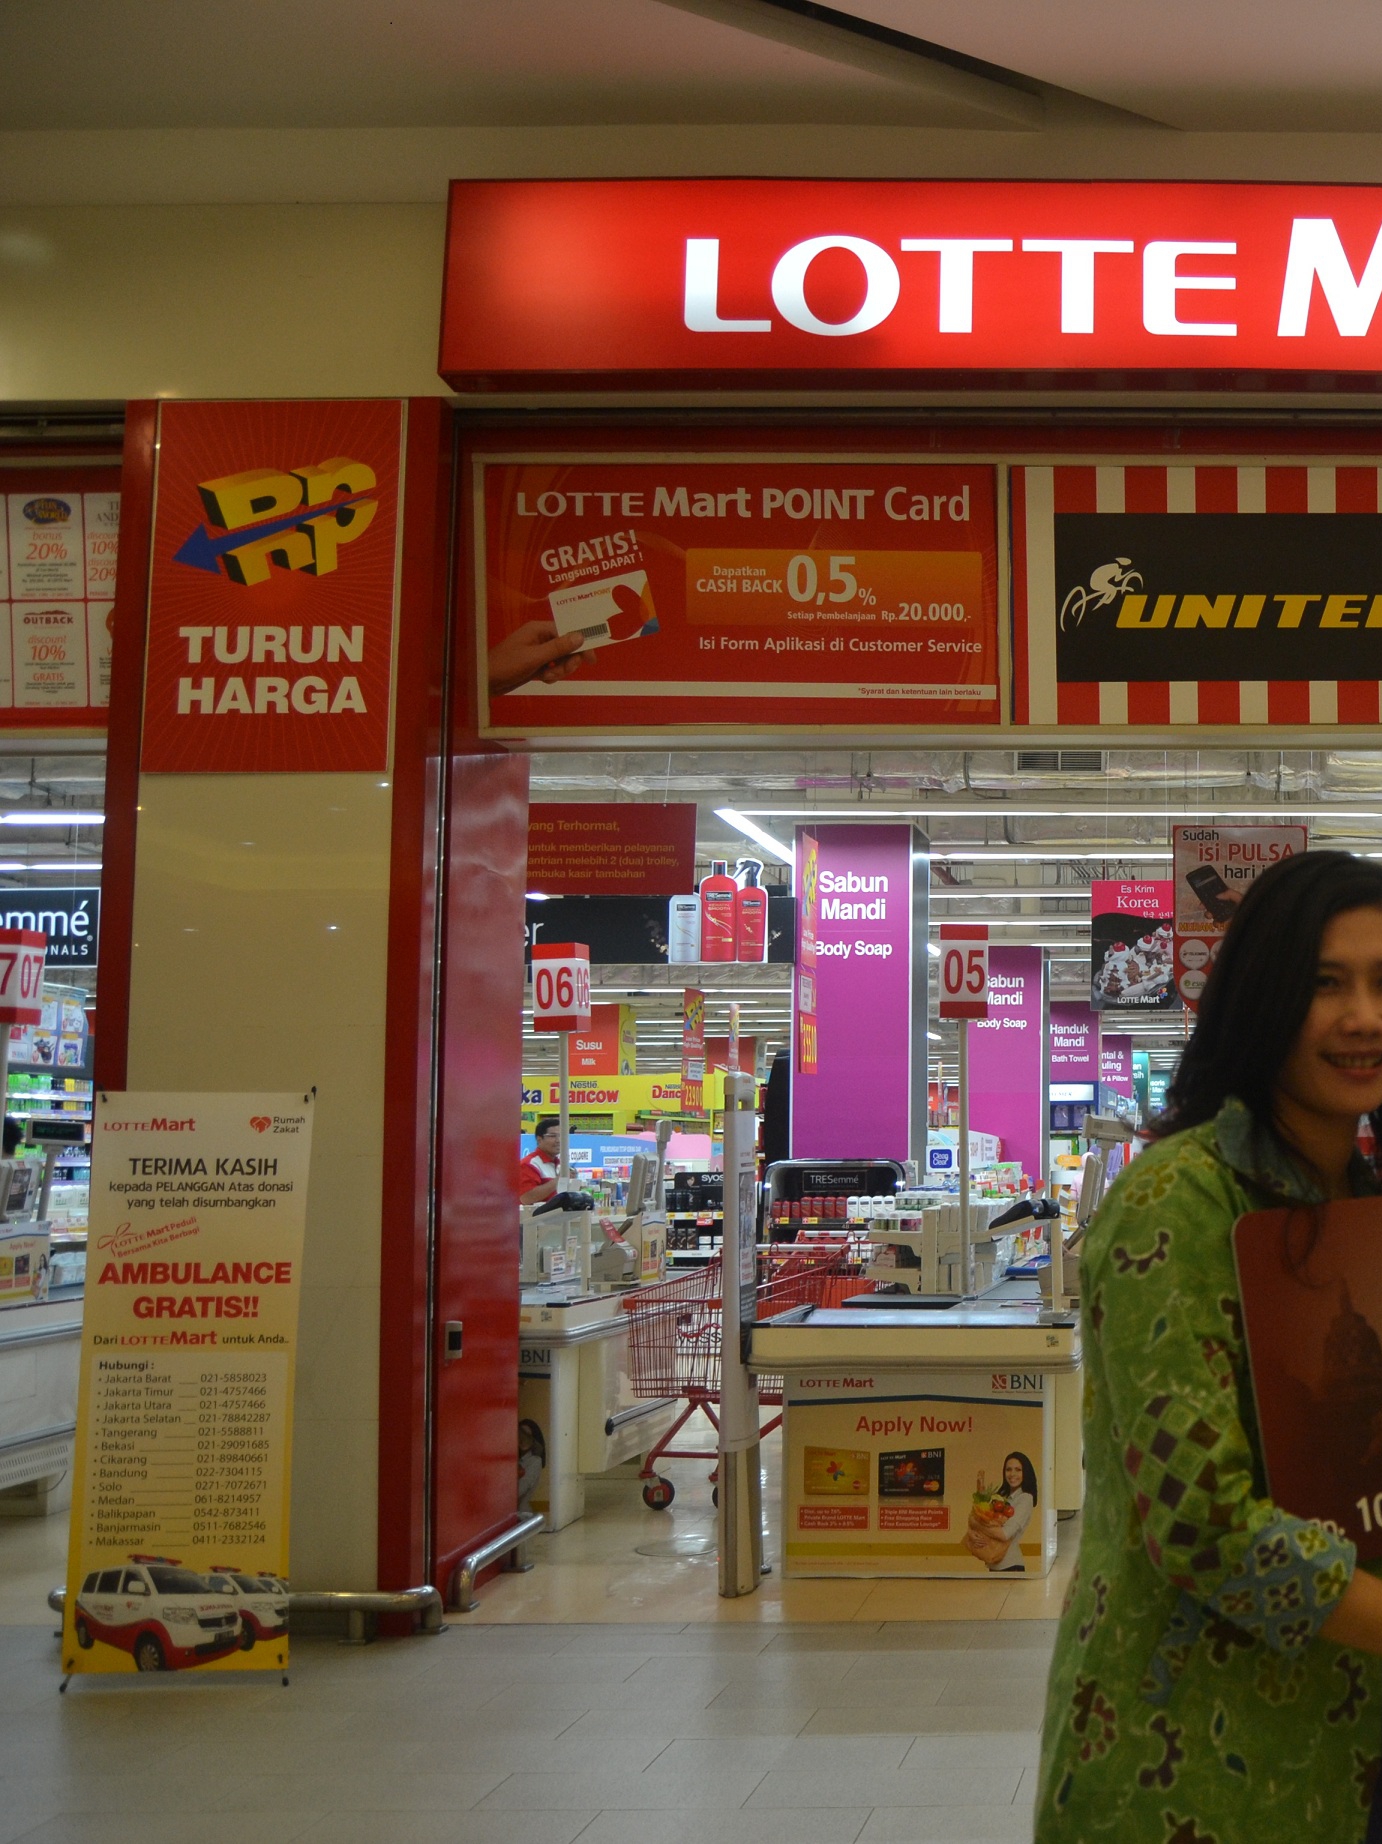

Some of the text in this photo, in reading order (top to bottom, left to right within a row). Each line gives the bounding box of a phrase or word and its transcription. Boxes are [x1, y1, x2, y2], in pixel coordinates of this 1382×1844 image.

[683, 234, 1238, 337] LOTTE
[517, 485, 972, 522] LOTTE Mart POINT Card
[26, 543, 68, 560] 20%
[540, 529, 640, 572] GRATIS!
[548, 563, 600, 584] Langsung
[712, 566, 767, 579] Dapatkan
[696, 579, 784, 594] CASH BACK
[23, 617, 74, 625] OUTBACK
[787, 611, 815, 622] Setiap
[816, 611, 876, 622] Pembelanjaan
[179, 625, 364, 664] TURUN
[699, 638, 983, 654] Isi Form Aplikasi di Customer Service
[30, 645, 66, 661] 10%
[176, 676, 368, 716] HARGA
[557, 820, 620, 832] Terhormat,
[1182, 830, 1220, 841] Sudah
[1198, 843, 1296, 862] isi PULSA
[1224, 864, 1256, 879] hari
[818, 871, 889, 893] Sabun
[1120, 884, 1155, 893] Es Krim
[1116, 896, 1160, 909] Korea
[820, 899, 887, 921] Mandi
[815, 941, 893, 960] Body Soap
[944, 949, 985, 995] 05
[536, 966, 575, 1010] 06
[576, 967, 590, 1009] 06
[1117, 995, 1161, 1005] LOTTE Mart
[1002, 1017, 1029, 1029] Soap
[1050, 1024, 1089, 1035] Handuk
[576, 1039, 603, 1050] Susu
[1054, 1036, 1085, 1047] Mandi
[581, 1056, 596, 1065] Milk
[1051, 1054, 1090, 1062] Bath Towel
[549, 1082, 620, 1104] Dancow
[273, 1116, 306, 1125] Rumah
[273, 1125, 300, 1134] Zakat
[129, 1158, 278, 1176] TERIMA KASIH
[810, 1174, 860, 1185] TRESemmé
[109, 1181, 293, 1194] kepada PELANGGAN Atas donasi
[127, 1197, 276, 1210] yang telah disumbangkan
[97, 1261, 292, 1286] AMBULANCE
[133, 1295, 260, 1320] GRATIS!!
[93, 1334, 118, 1346] Dari
[222, 1333, 255, 1345] untuk
[99, 1360, 150, 1374] Hubungi
[104, 1373, 267, 1384] Jakarta Barat 021-5858023
[800, 1376, 875, 1388] LOTTE Mart
[1010, 1374, 1044, 1390] BNI
[103, 1386, 267, 1398] Jakarta Timur 021-4757466
[199, 1400, 266, 1410] 021-4757466
[199, 1413, 271, 1424] 021-78842287
[198, 1427, 264, 1437] 021-5588811
[855, 1415, 973, 1437] Apply Now!
